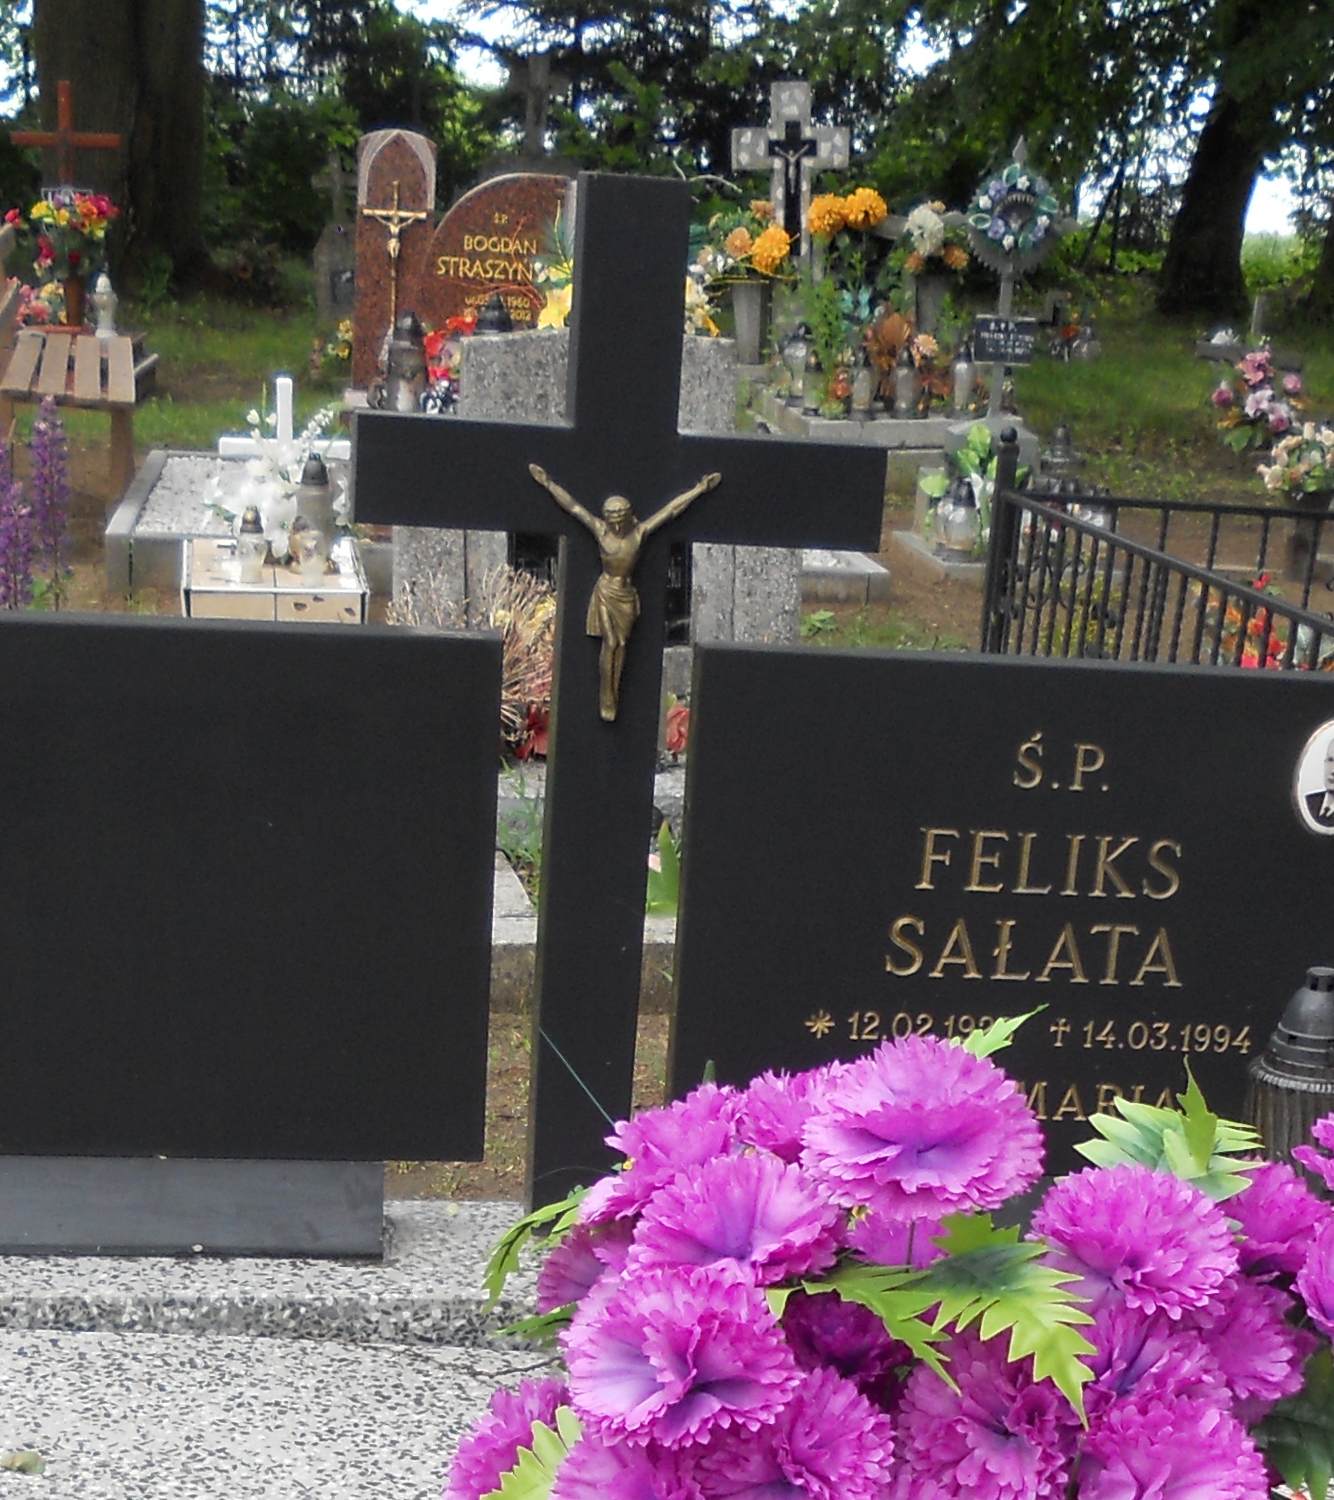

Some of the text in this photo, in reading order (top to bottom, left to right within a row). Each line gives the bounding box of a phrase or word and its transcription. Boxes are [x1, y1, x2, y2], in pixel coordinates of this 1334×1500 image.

[463, 235, 537, 255] BOGDAN
[1013, 731, 1109, 792] Ś.P.
[914, 826, 1182, 900] FELIKS
[884, 913, 1183, 987] SAŁATA
[1082, 1020, 1253, 1055] 14.03.1994
